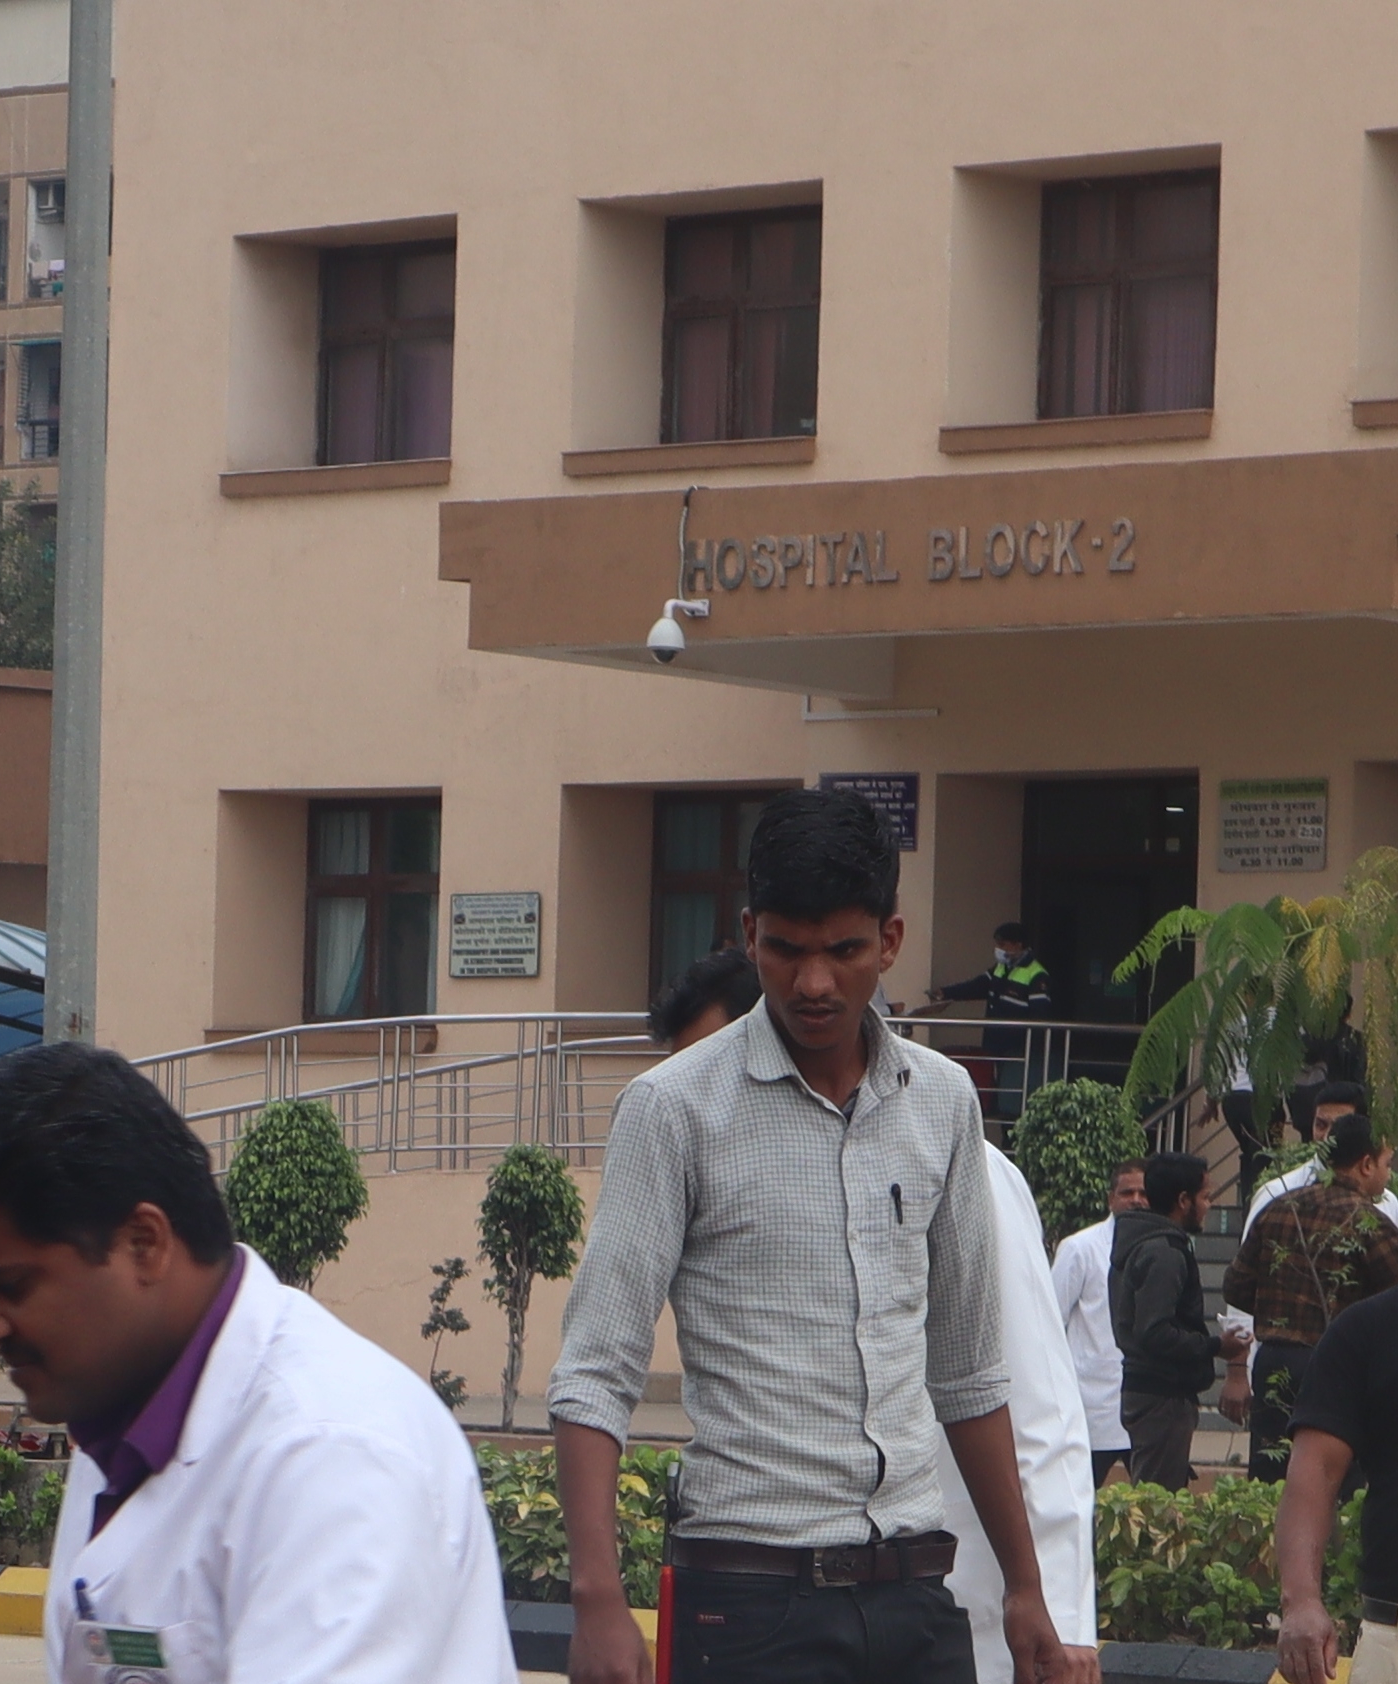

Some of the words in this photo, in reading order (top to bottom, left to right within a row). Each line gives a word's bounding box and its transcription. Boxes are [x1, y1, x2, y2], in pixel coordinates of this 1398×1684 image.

[686, 530, 899, 591] HOSPITAL
[927, 517, 1135, 582] BLOCK-2
[1297, 815, 1322, 825] 11.00
